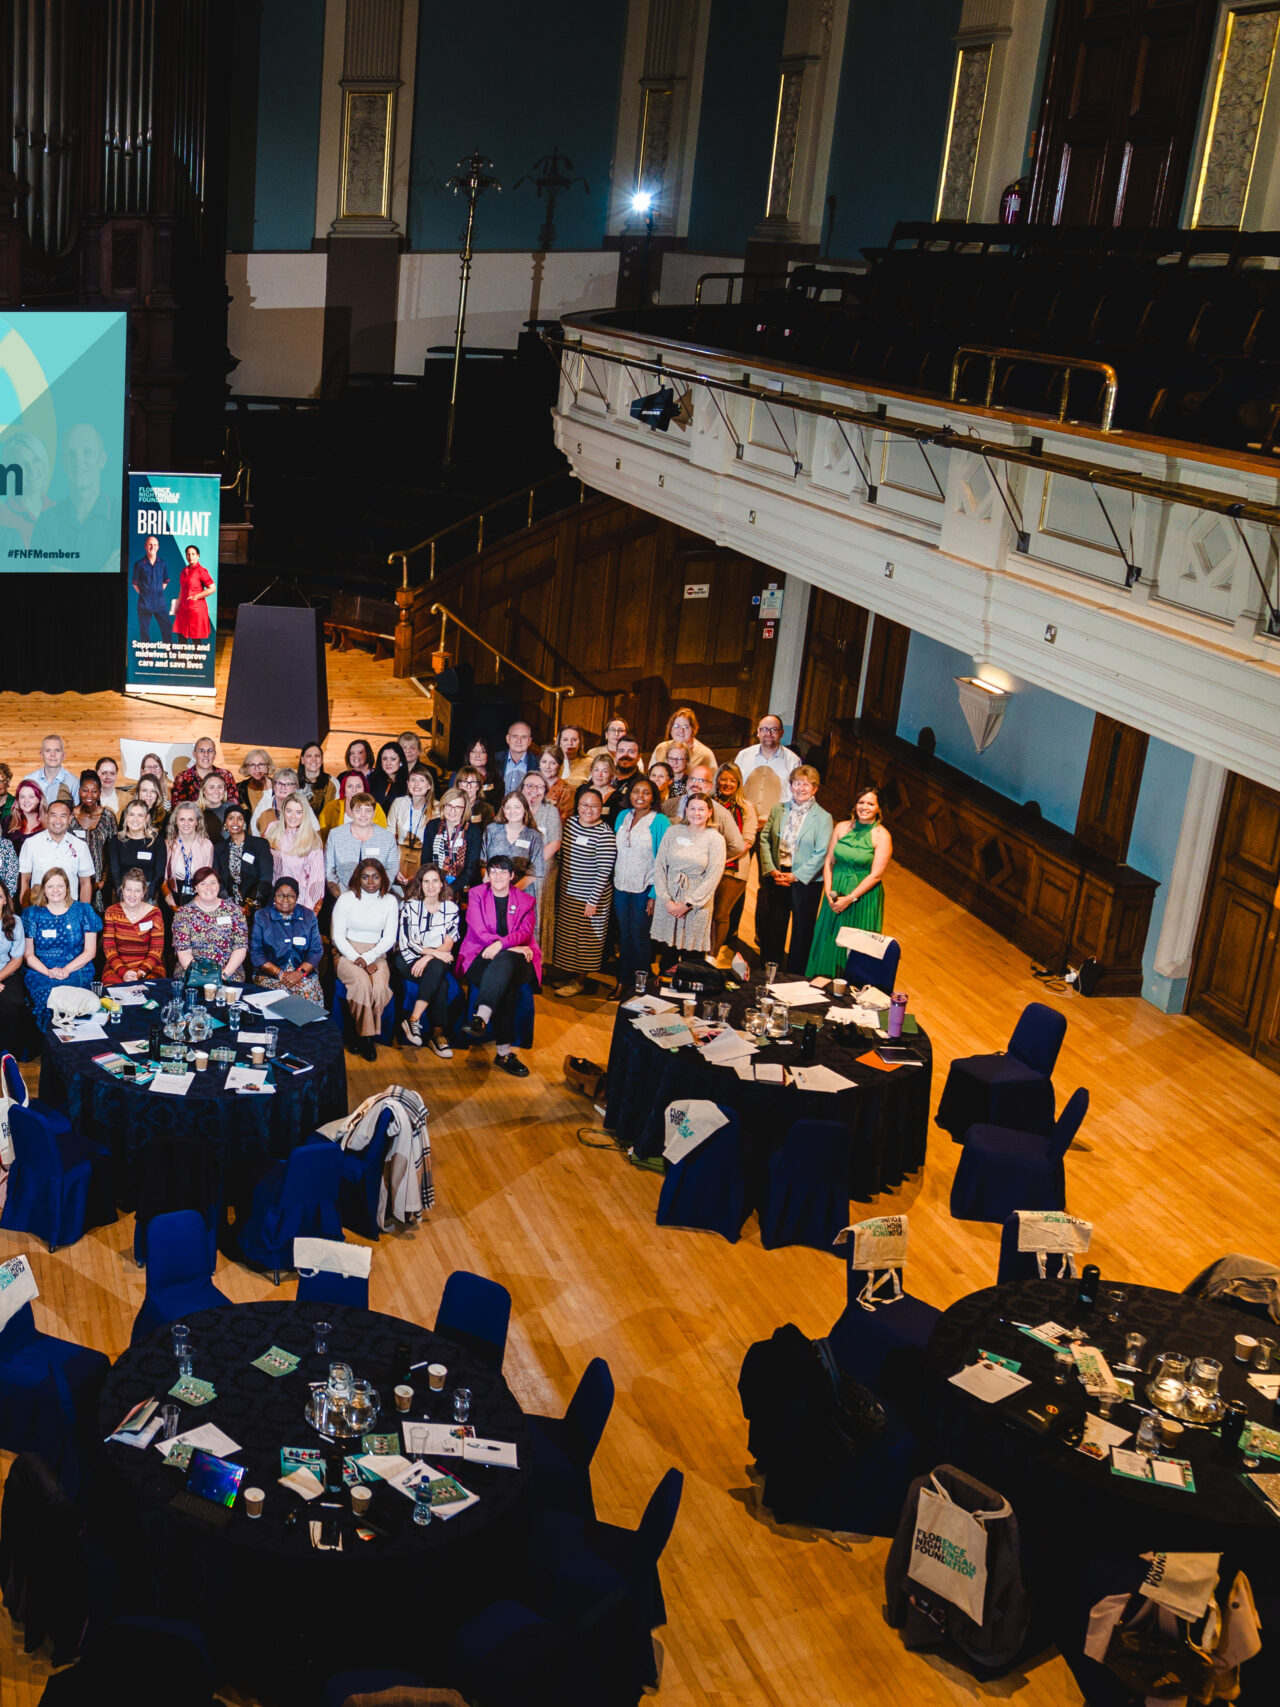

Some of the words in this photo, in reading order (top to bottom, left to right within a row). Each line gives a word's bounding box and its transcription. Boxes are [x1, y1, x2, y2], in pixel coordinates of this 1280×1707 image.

[137, 509, 212, 537] BRILLIANT
[7, 549, 81, 560] #FNFMembers
[131, 640, 171, 651] Supporting
[172, 643, 195, 651] nurses
[196, 643, 211, 652] and
[135, 650, 168, 659] midwives
[168, 651, 177, 659] to
[177, 651, 207, 661] improve
[138, 659, 154, 667] care
[155, 659, 169, 668] and
[169, 661, 186, 669] save
[186, 661, 204, 669] lives
[917, 1528, 968, 1558] FLORENCE
[914, 1543, 974, 1580] FOUNDATION
